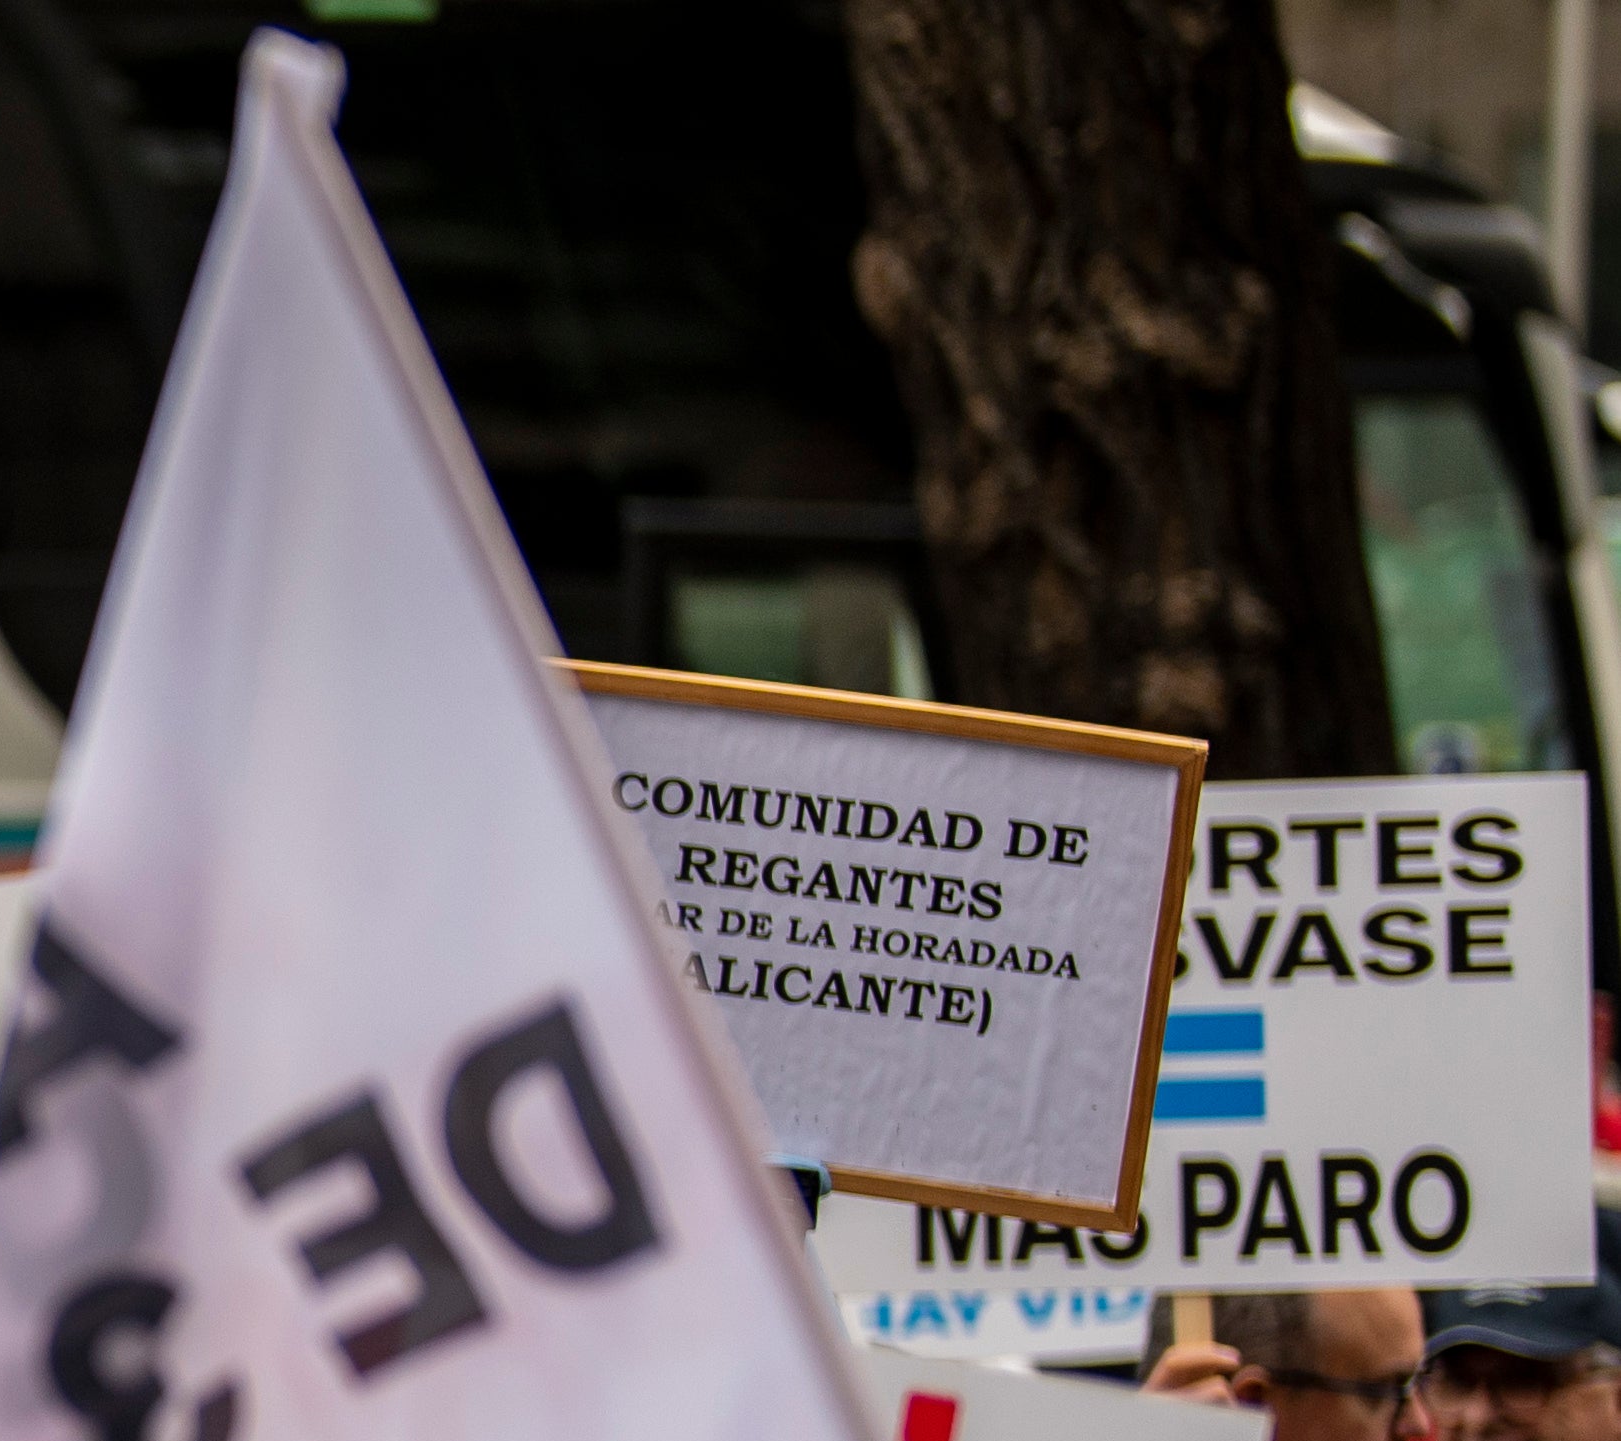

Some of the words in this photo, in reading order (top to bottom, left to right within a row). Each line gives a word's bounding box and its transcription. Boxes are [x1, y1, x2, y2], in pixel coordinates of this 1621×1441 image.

[611, 771, 984, 852] COMUNIDAD
[1004, 819, 1090, 867] DE
[1193, 812, 1525, 892] RTES
[675, 843, 1005, 922] REGANTES
[718, 908, 773, 940] DE
[787, 916, 837, 950] LA
[850, 925, 1081, 981] HORADADA
[1179, 1151, 1471, 1262] PARO
